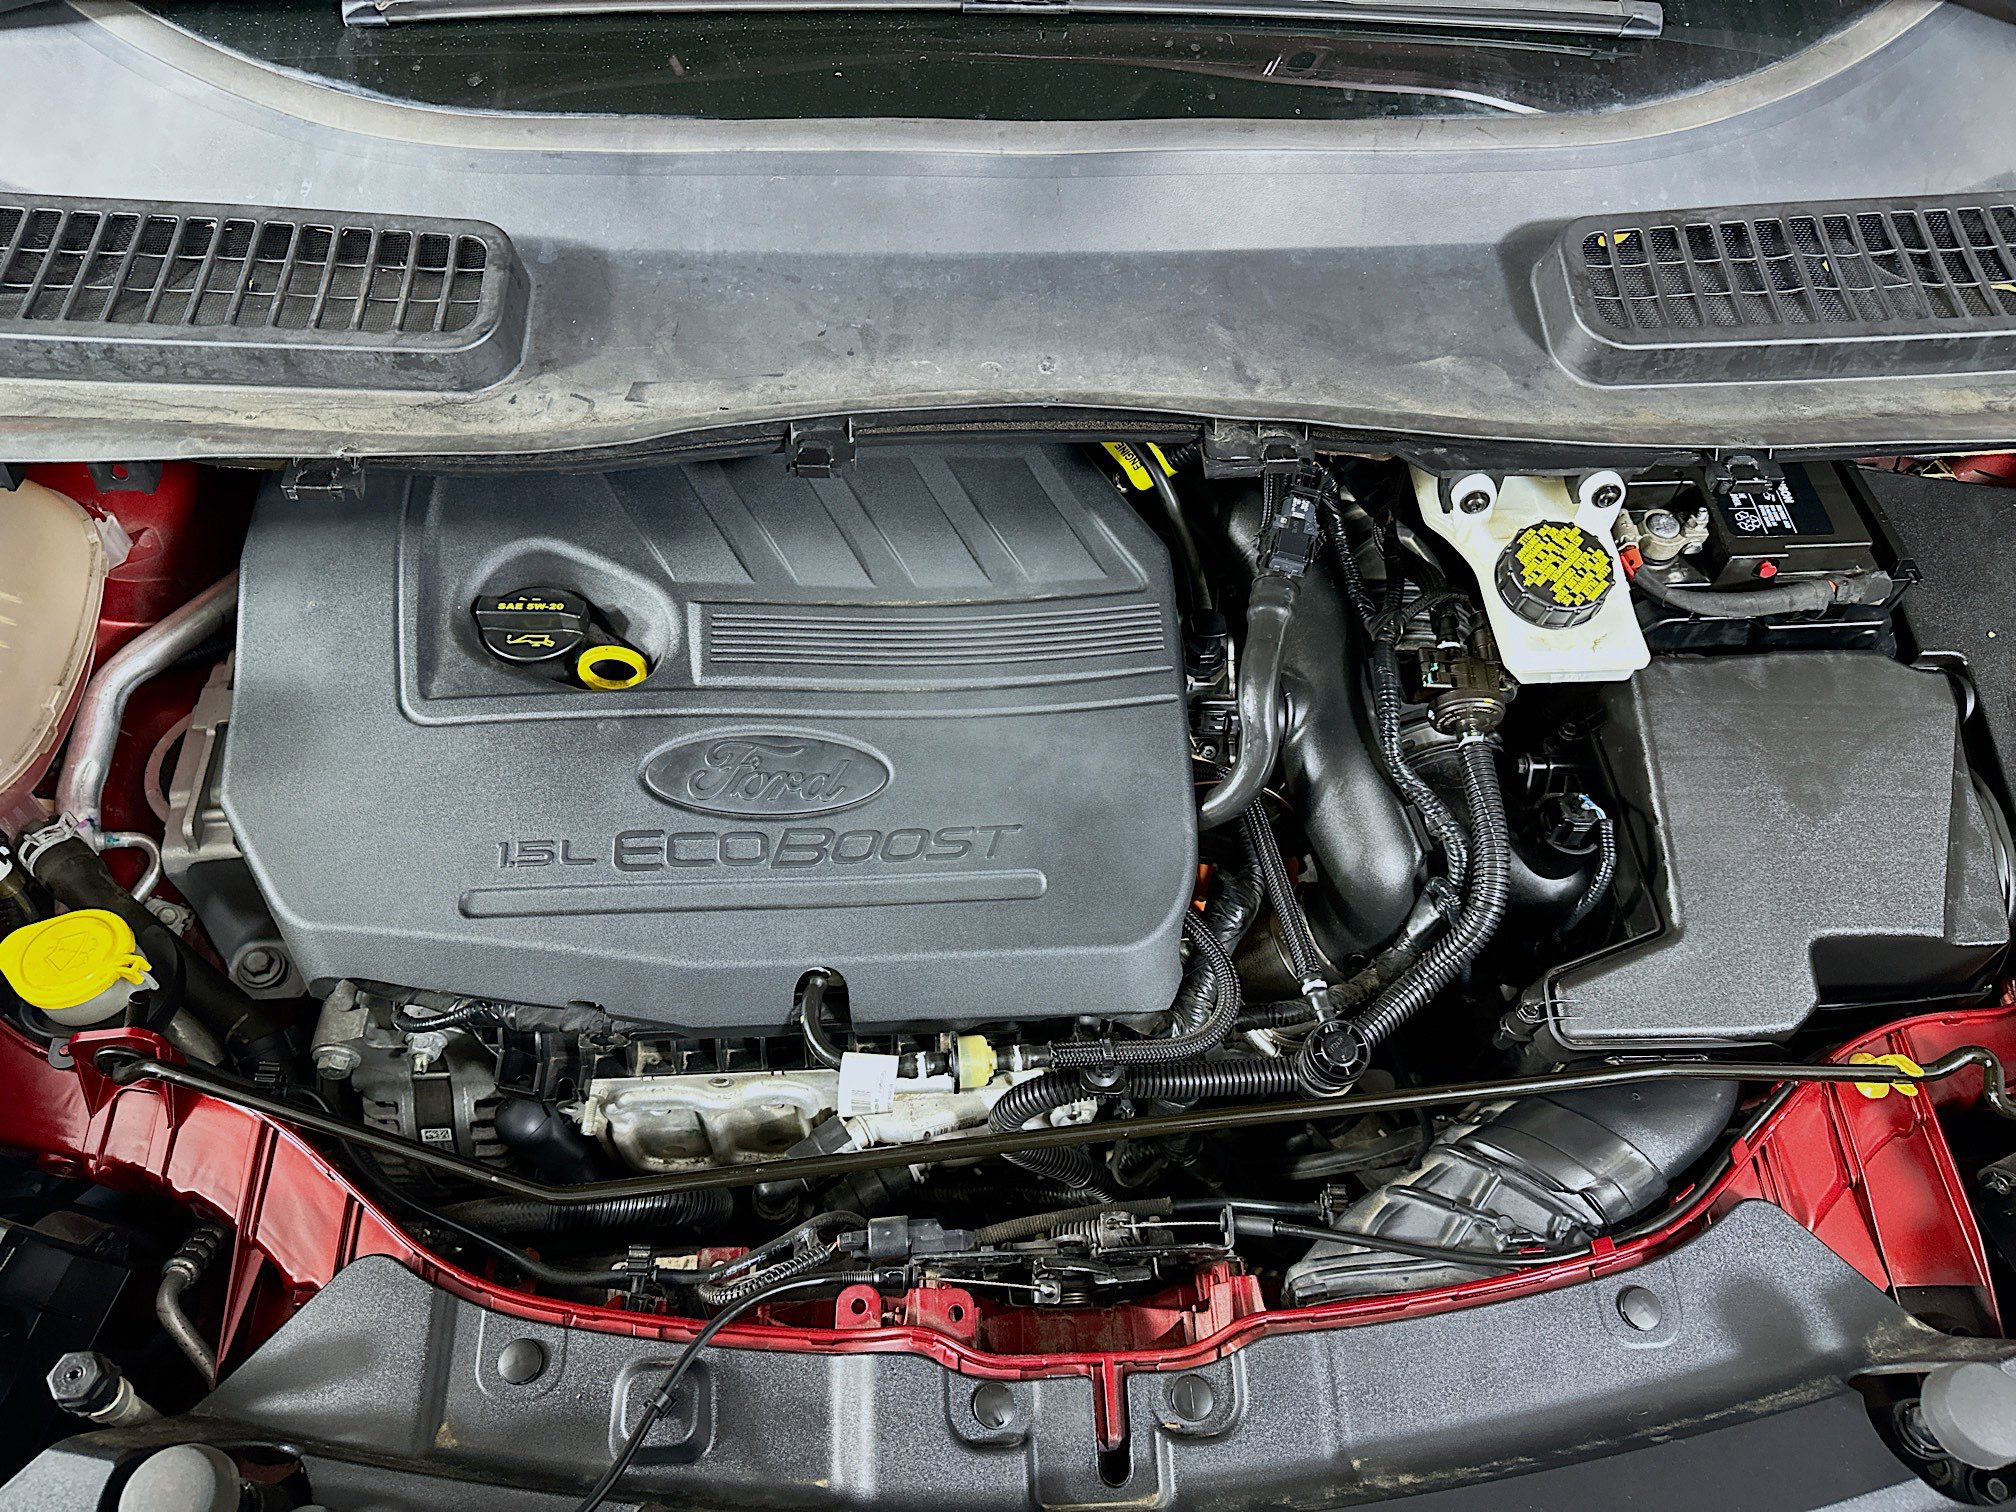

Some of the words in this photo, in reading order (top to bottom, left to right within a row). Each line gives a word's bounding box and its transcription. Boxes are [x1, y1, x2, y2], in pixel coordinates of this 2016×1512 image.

[1114, 441, 1141, 470] ENGINE
[498, 602, 523, 610] SAE
[526, 602, 564, 610] 5W-20
[686, 740, 853, 803] Ford
[497, 838, 597, 869] 1.5L
